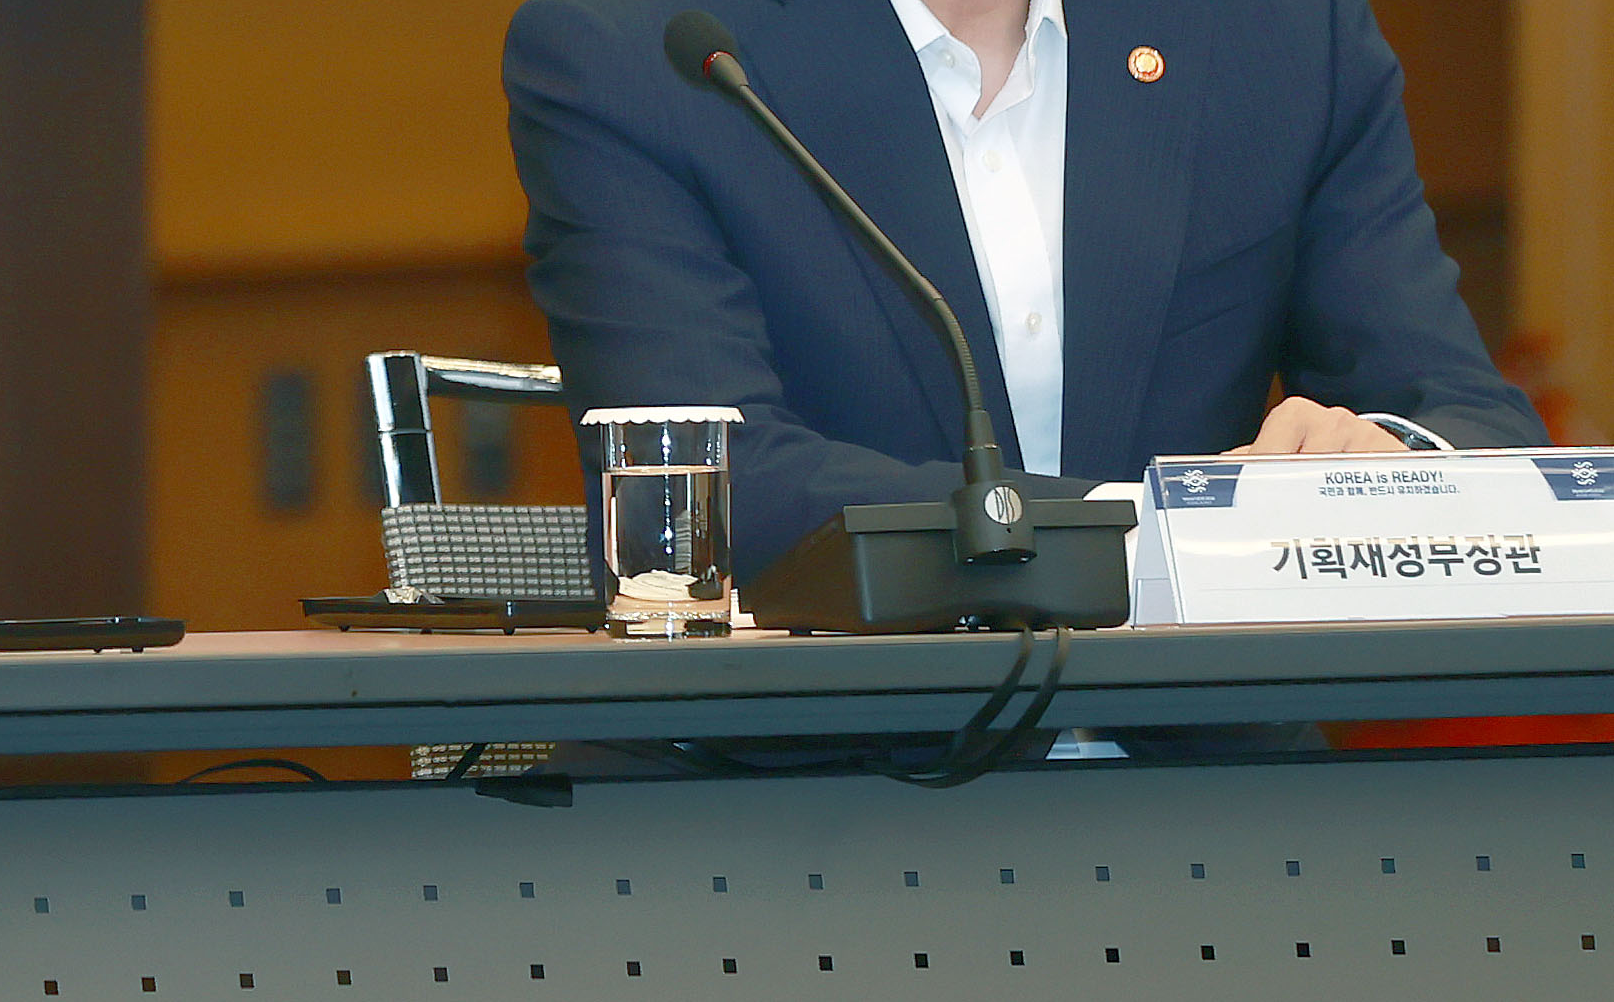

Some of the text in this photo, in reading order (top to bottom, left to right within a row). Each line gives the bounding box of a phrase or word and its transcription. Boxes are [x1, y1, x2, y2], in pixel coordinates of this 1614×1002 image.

[1325, 470, 1444, 485] KOREA is READY!
[1270, 533, 1542, 580] 기획재정부장관
